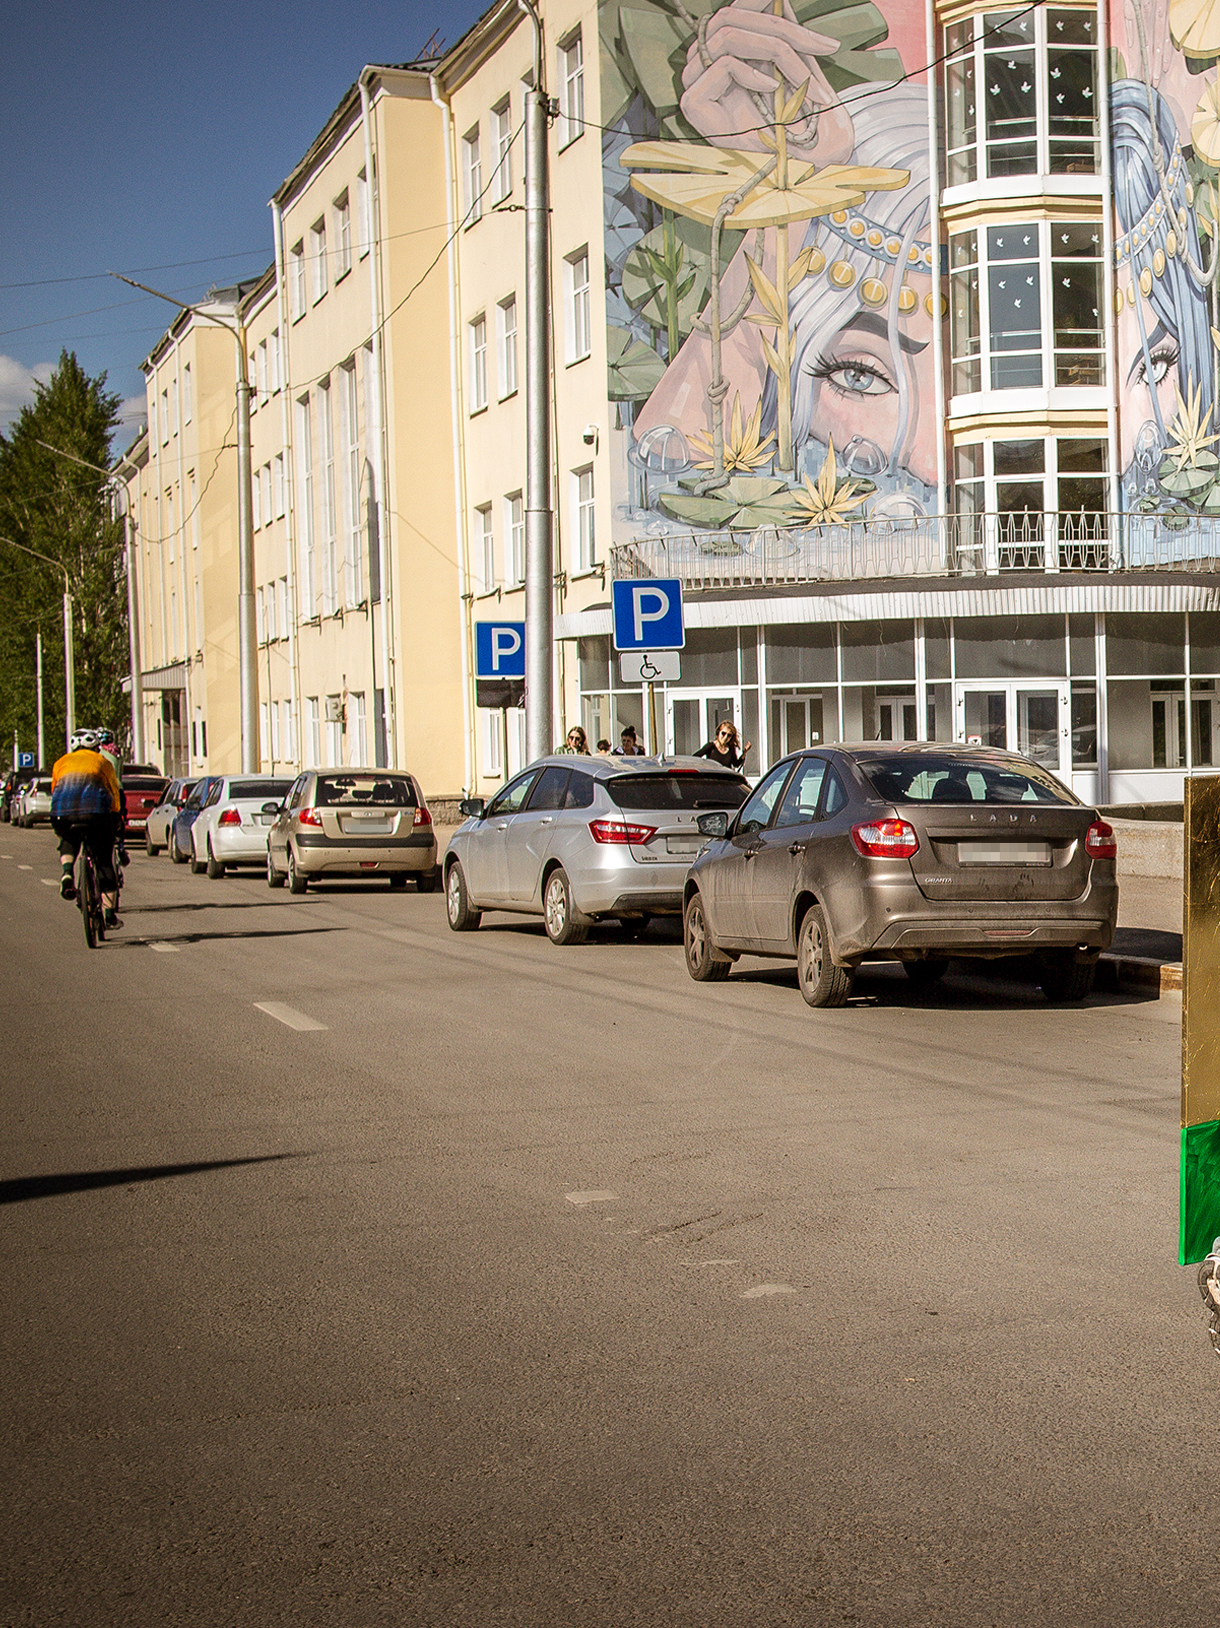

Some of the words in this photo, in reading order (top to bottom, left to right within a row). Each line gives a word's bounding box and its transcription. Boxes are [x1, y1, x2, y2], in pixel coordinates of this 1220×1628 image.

[632, 586, 670, 642] P
[491, 627, 521, 671] P
[23, 754, 31, 766] P
[969, 813, 1037, 823] LADA
